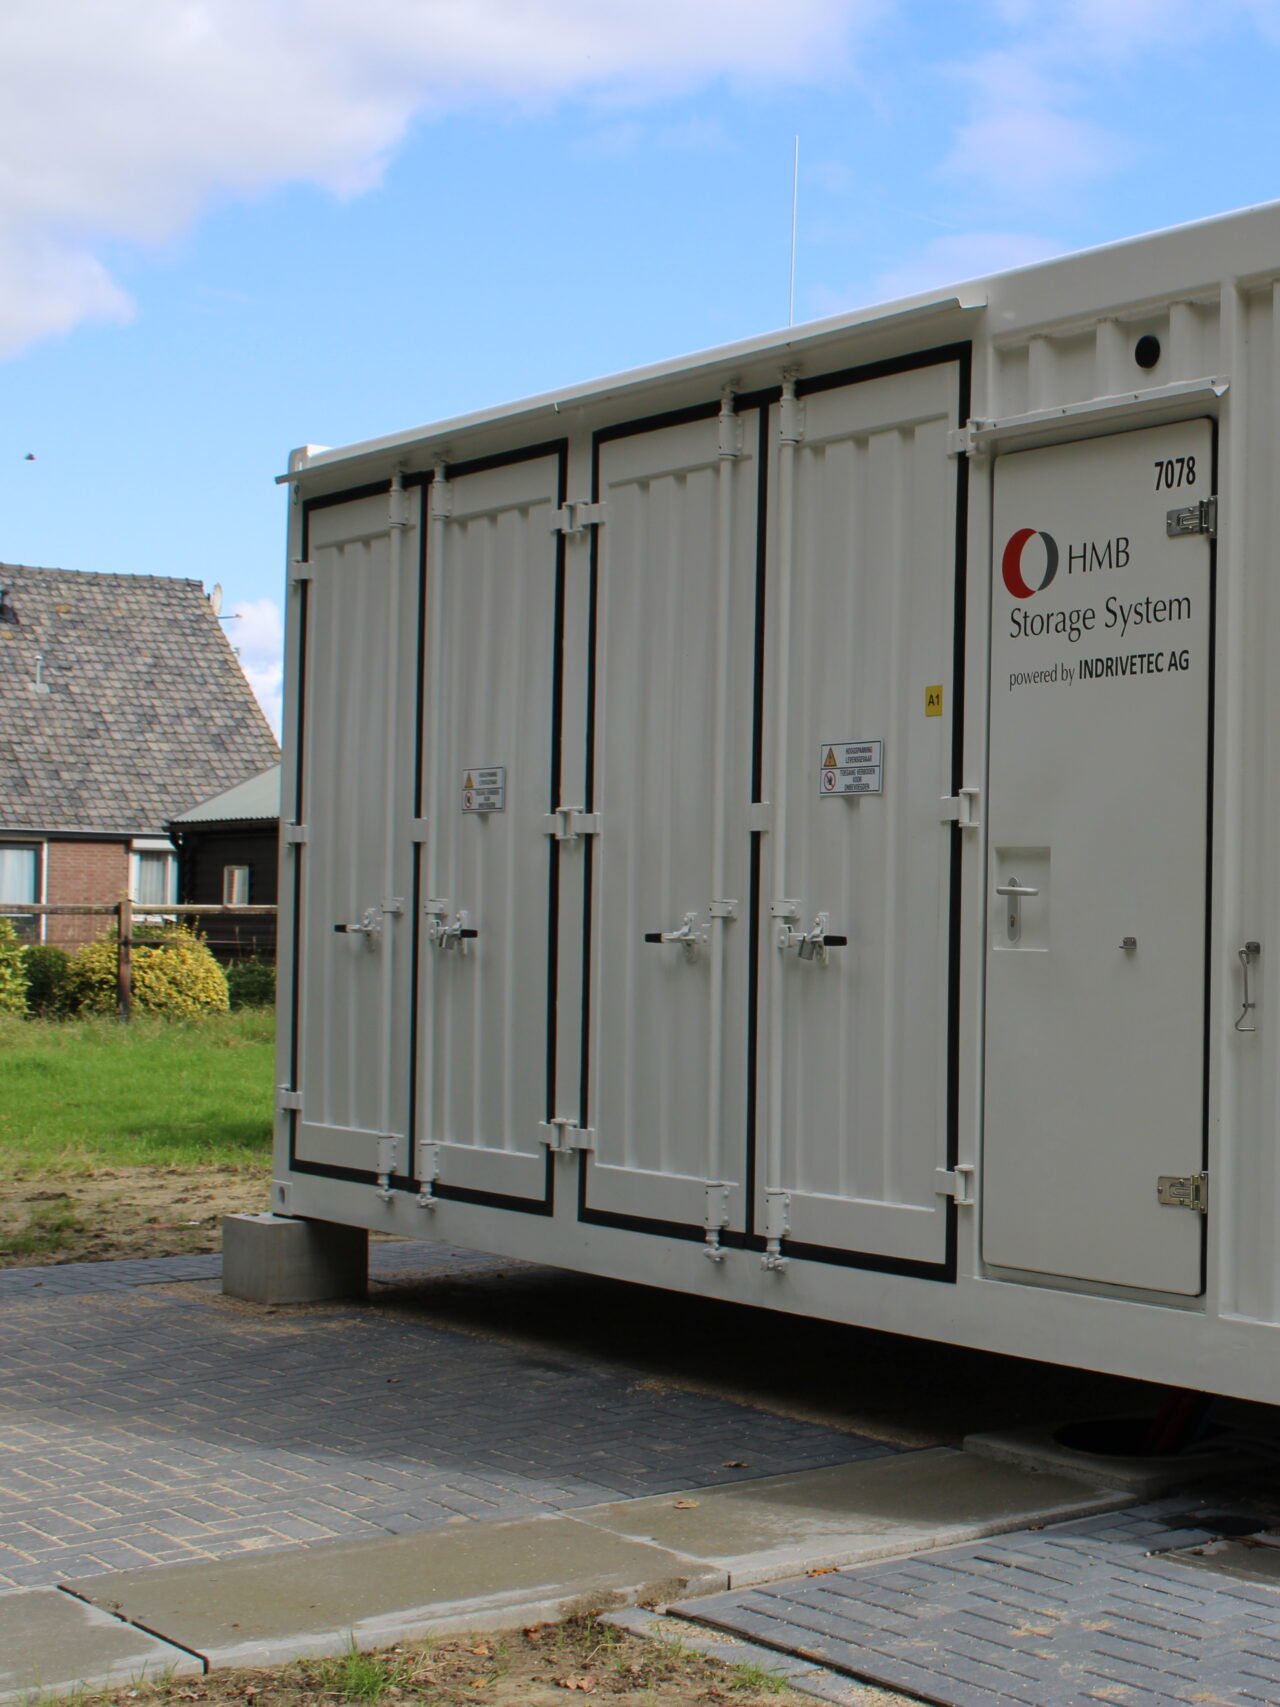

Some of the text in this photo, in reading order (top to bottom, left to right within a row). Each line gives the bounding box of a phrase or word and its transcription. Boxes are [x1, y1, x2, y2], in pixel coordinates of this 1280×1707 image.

[1154, 456, 1196, 491] 7078
[1068, 537, 1130, 574] HMB
[1010, 596, 1192, 643] Storage System
[1010, 650, 1190, 692] powered by INDRIVETEC AG
[927, 693, 940, 707] A1
